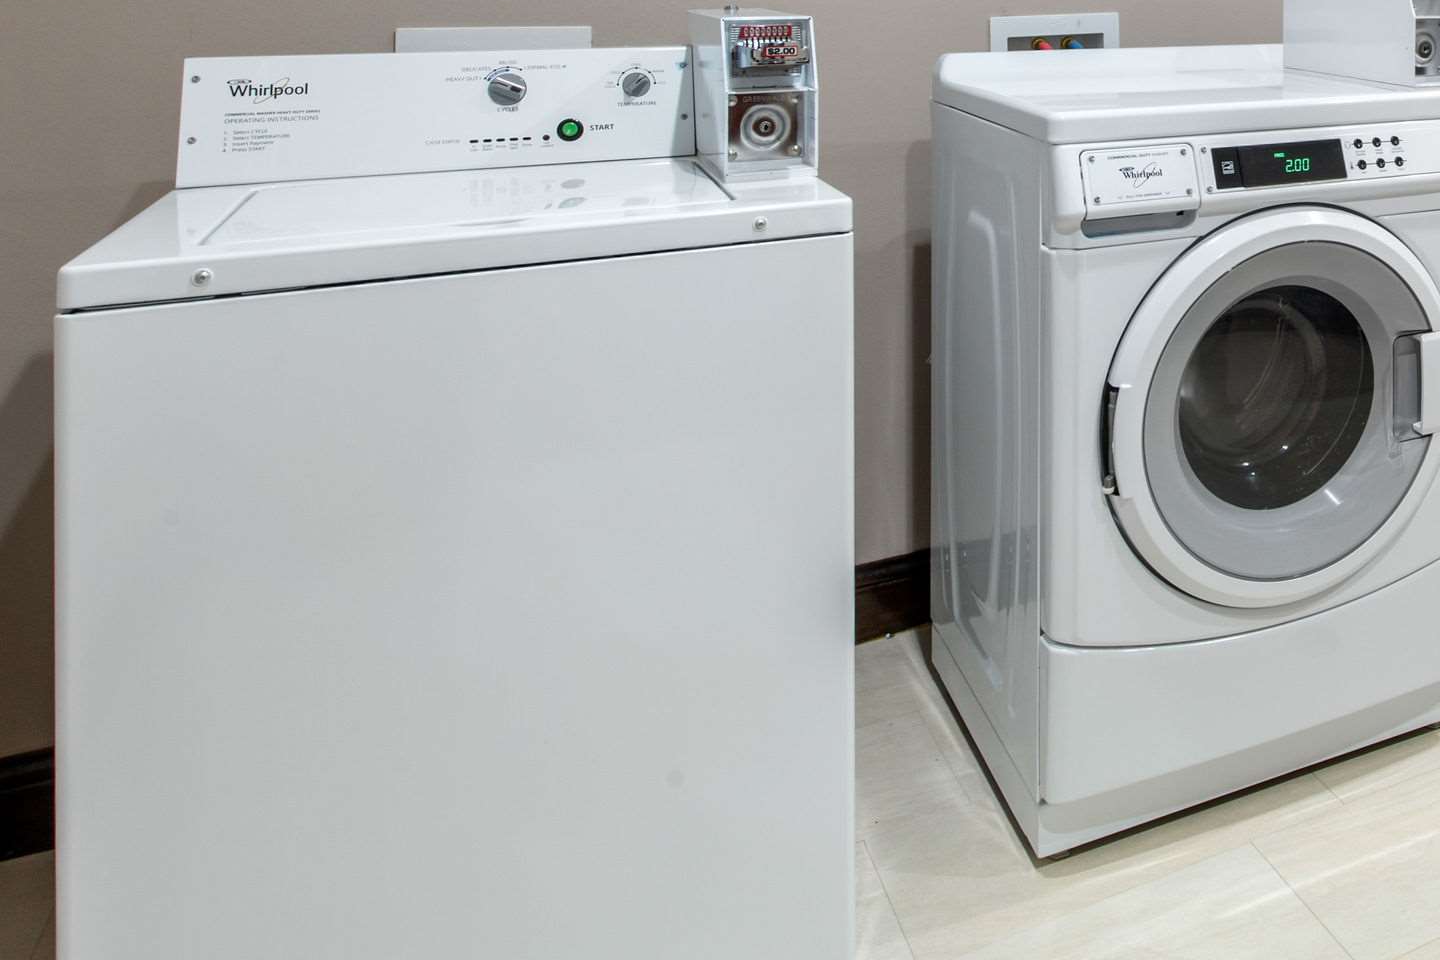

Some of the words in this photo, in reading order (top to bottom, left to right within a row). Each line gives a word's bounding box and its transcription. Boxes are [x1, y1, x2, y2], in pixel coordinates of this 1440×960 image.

[767, 47, 796, 55] $2.00
[229, 82, 309, 99] Whirlpool
[1285, 158, 1310, 172] 2.00
[1122, 168, 1163, 180] Whirlpool
